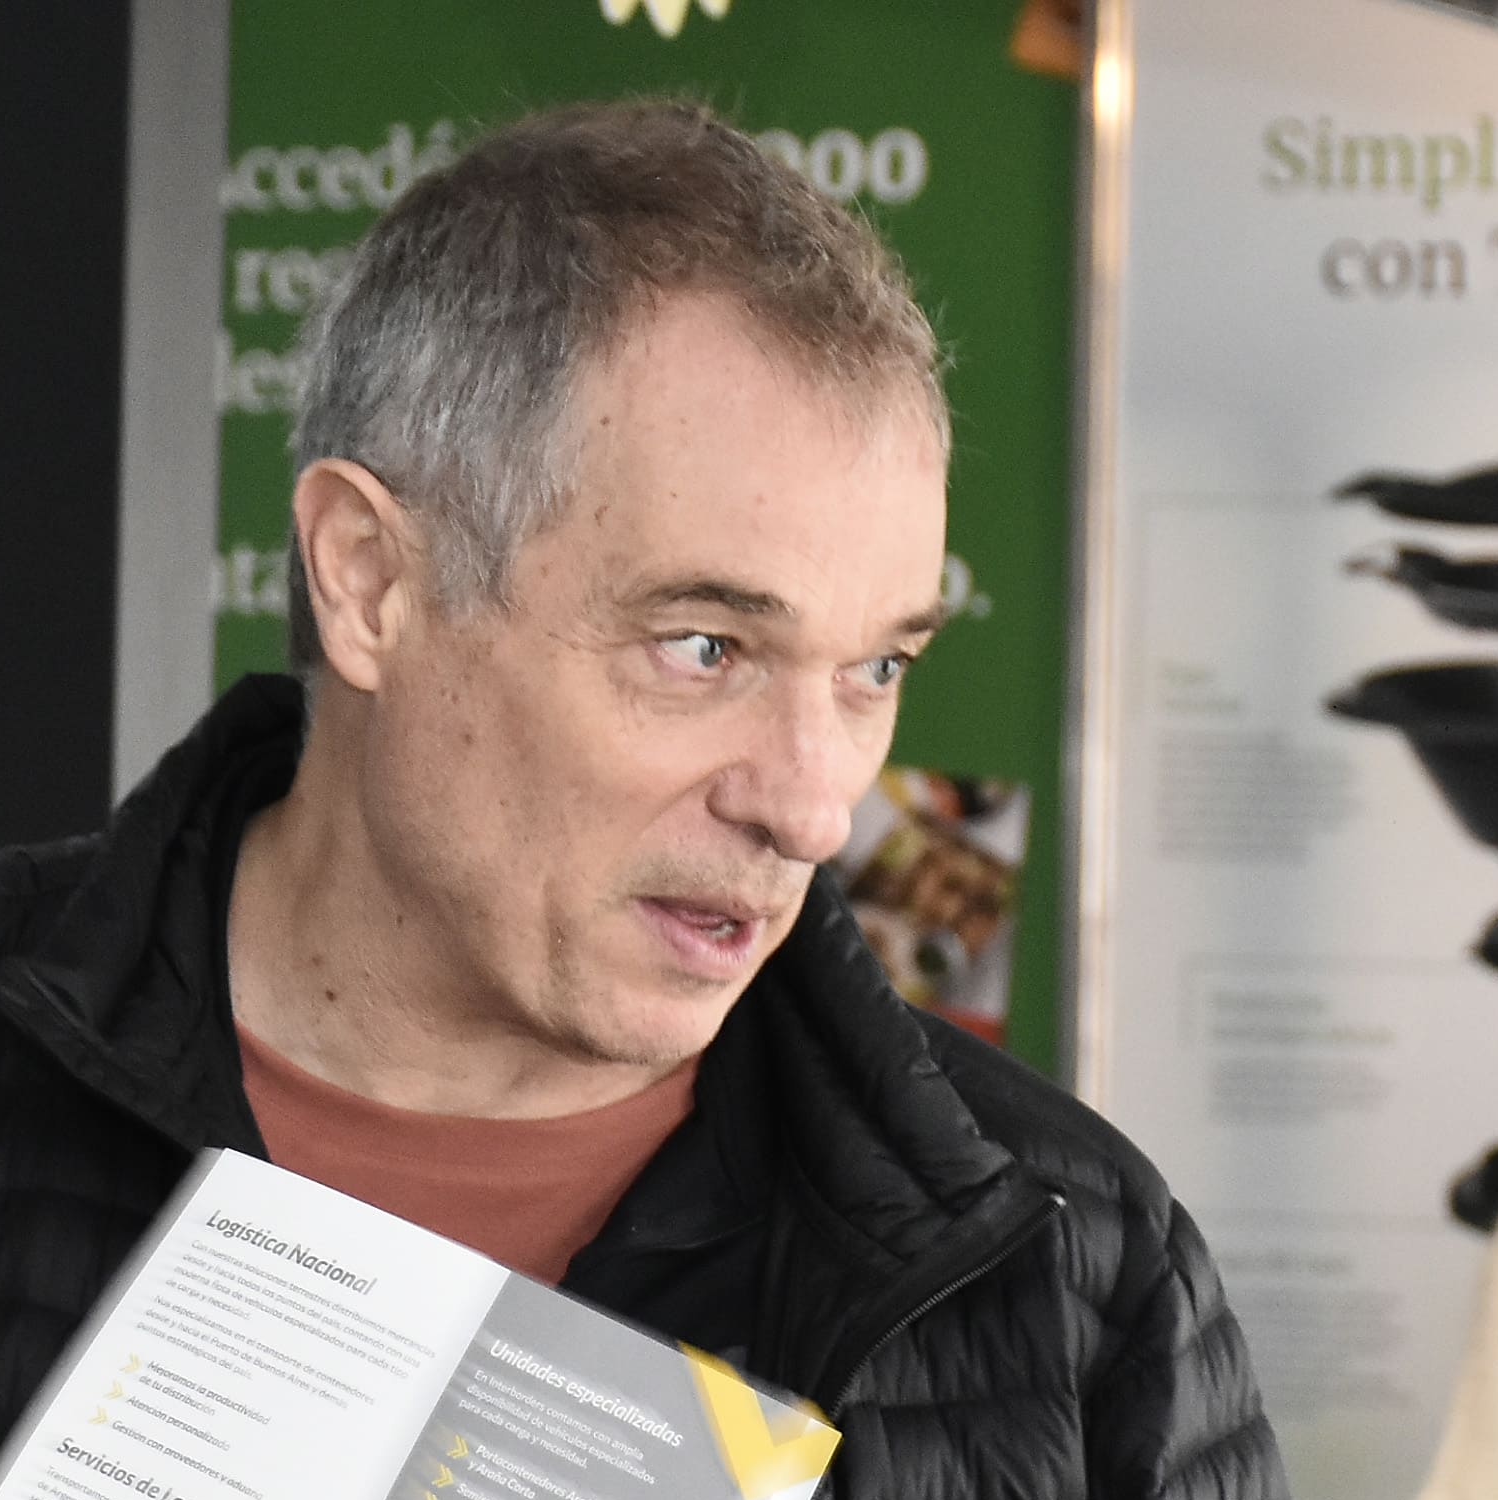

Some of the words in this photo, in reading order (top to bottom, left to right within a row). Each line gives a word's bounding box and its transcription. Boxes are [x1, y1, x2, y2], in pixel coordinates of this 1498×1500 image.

[1319, 236, 1471, 300] con
[204, 1208, 289, 1258] Logística
[283, 1243, 379, 1296] Nacional
[473, 1368, 488, 1383] En
[487, 1375, 546, 1412] Interborders
[545, 1406, 592, 1435] contamos
[592, 1430, 611, 1444] con
[487, 1339, 567, 1389] Unidades
[563, 1380, 685, 1448] especializadas
[54, 1435, 137, 1487] Servicios
[133, 1474, 162, 1500] de
[457, 1398, 480, 1415] para
[480, 1409, 504, 1426] cada
[503, 1421, 531, 1440] carga
[538, 1439, 587, 1469] necesidad.
[465, 1382, 531, 1422] disponibilidad
[530, 1414, 543, 1428] de
[587, 1445, 656, 1485] especializados
[474, 1443, 567, 1497] Portacontenedores
[474, 1462, 507, 1485] Araña
[505, 1477, 536, 1500] Corta
